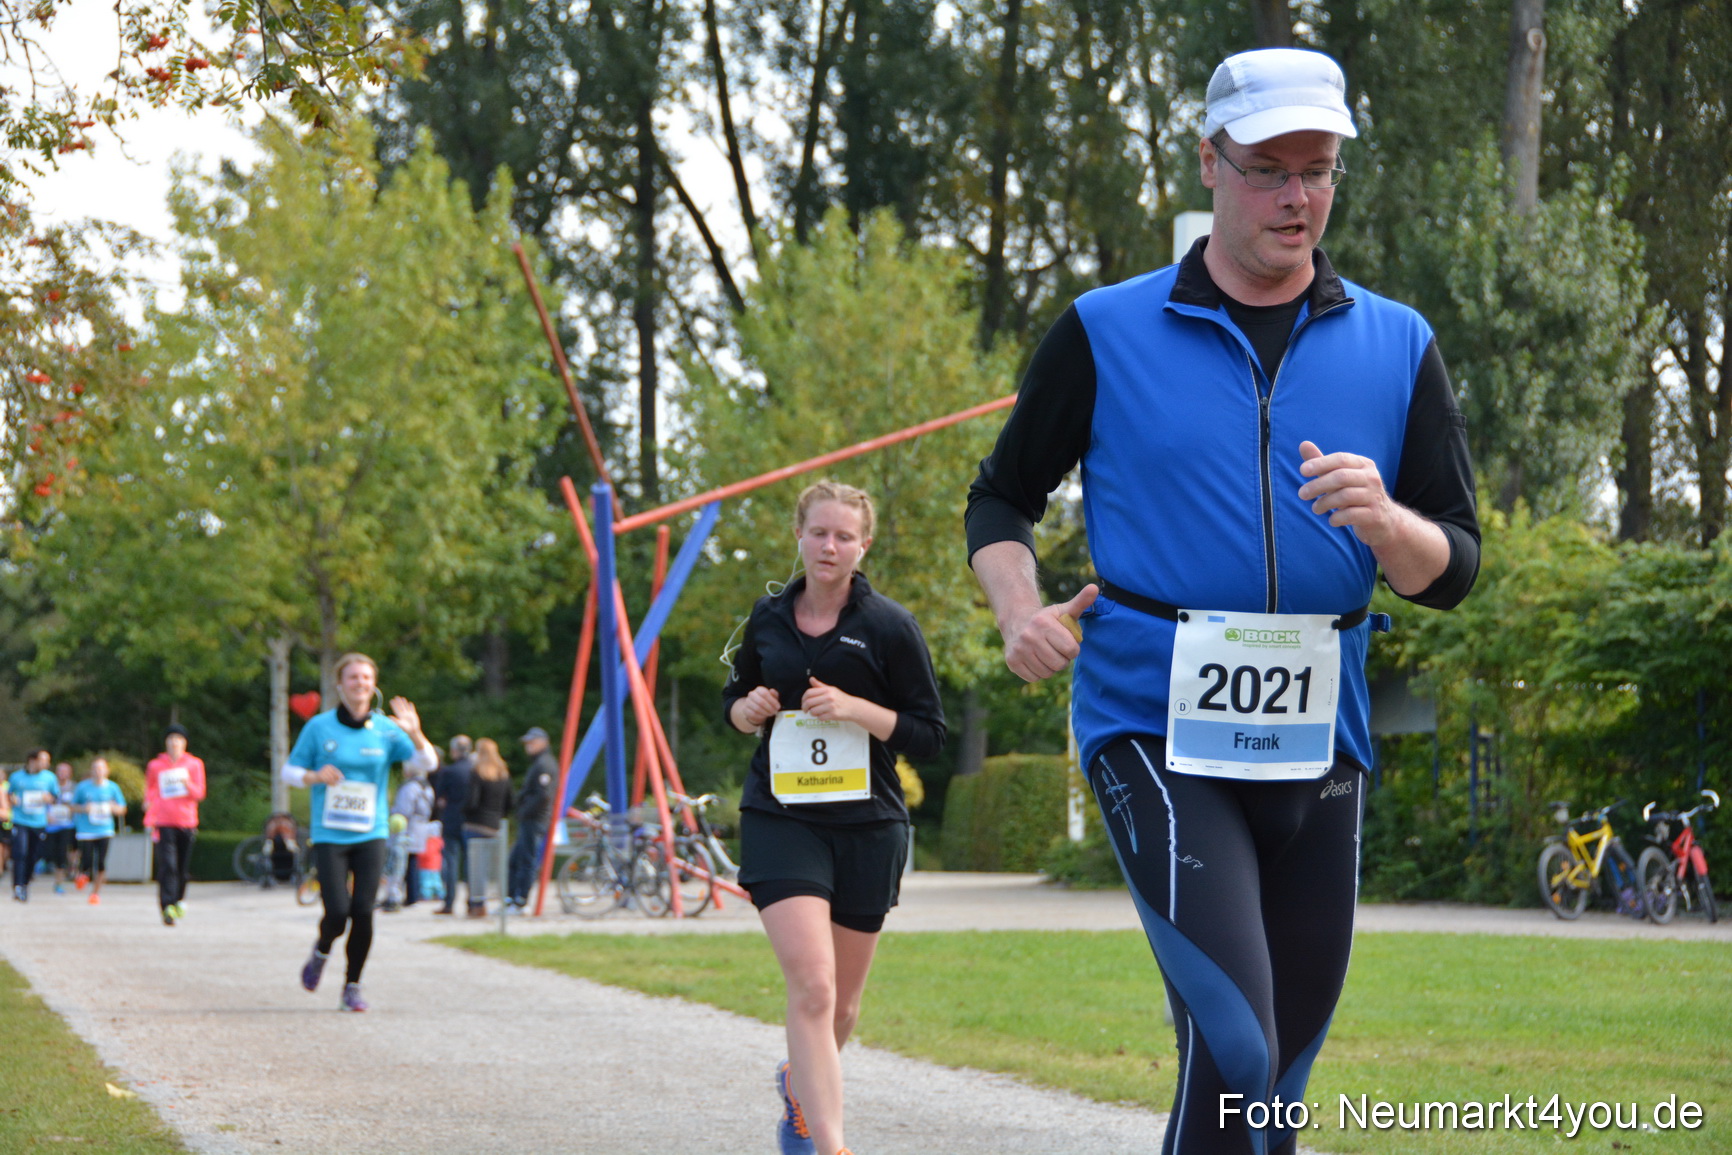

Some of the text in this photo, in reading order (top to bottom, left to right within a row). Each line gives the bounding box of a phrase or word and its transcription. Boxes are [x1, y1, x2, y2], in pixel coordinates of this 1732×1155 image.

[1242, 629, 1301, 643] BOCK
[1197, 662, 1312, 714] 2021
[1180, 702, 1186, 711] D
[1233, 731, 1280, 751] Frank
[811, 738, 828, 765] 8
[796, 774, 844, 787] Katharina
